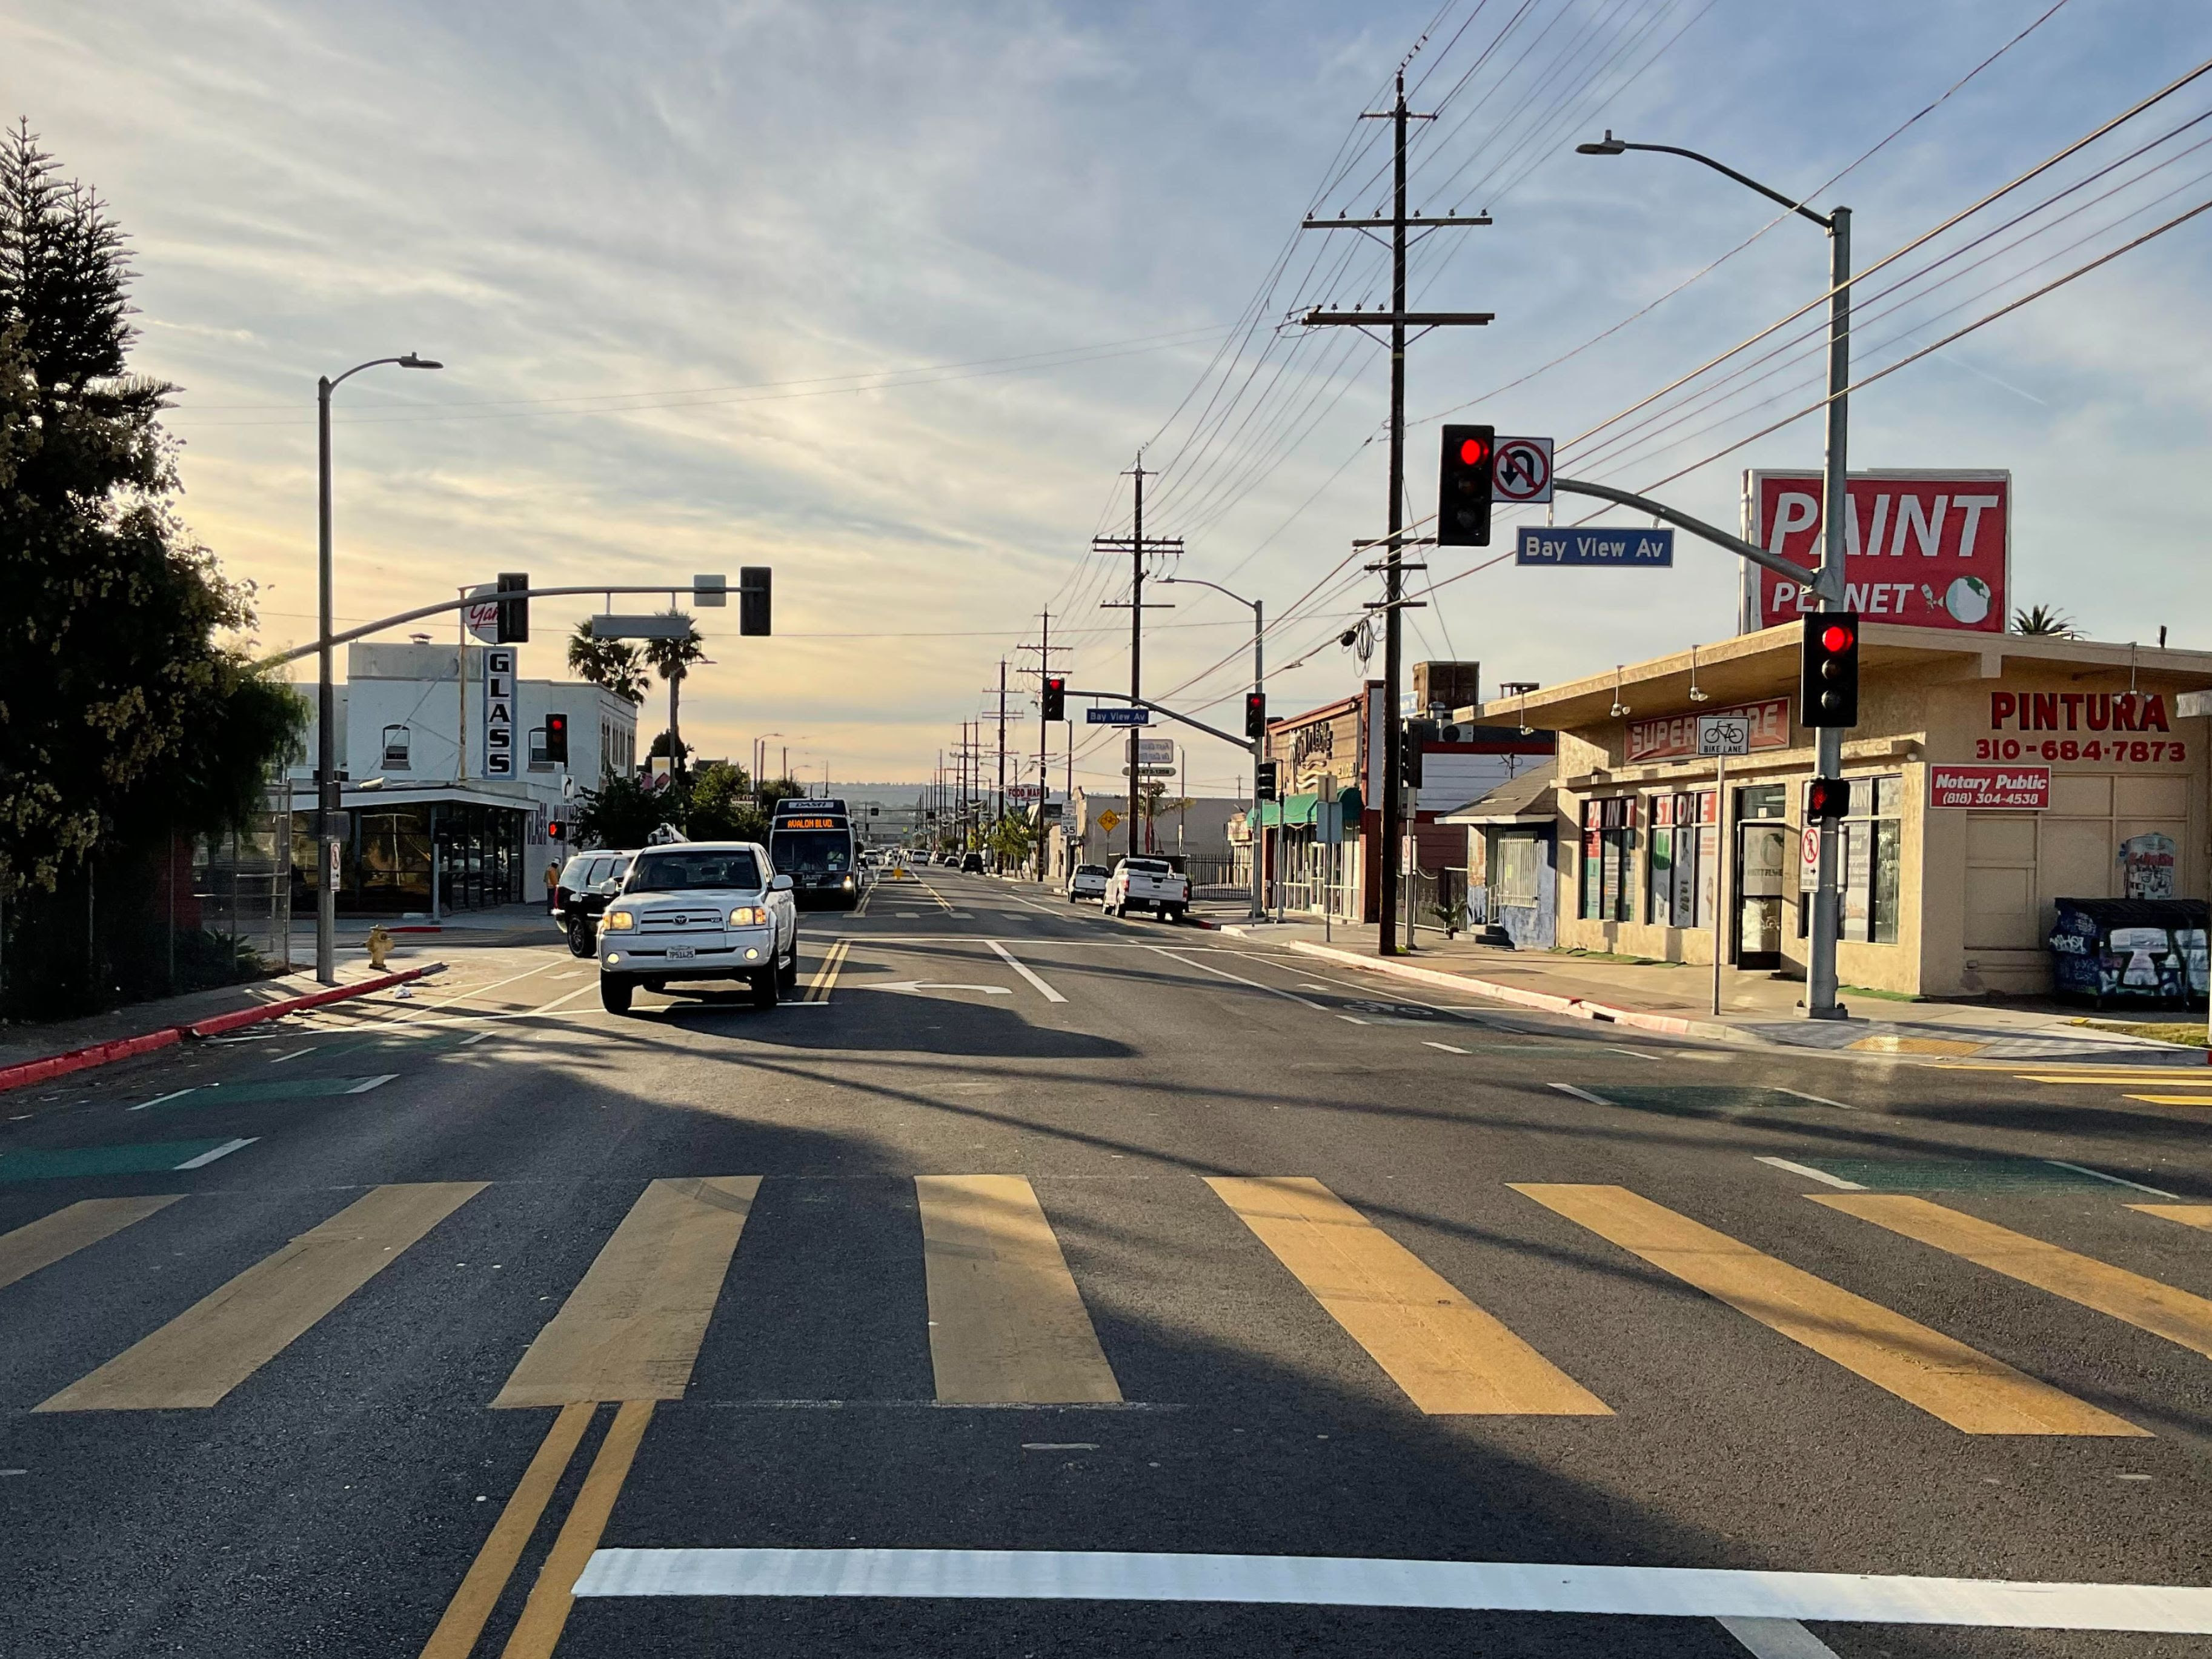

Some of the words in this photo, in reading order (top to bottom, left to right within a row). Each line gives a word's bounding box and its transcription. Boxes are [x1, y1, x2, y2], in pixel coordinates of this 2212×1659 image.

[1769, 492, 1999, 557] PAINT
[1526, 536, 1567, 561] Bay
[1576, 537, 1626, 557] View
[1635, 537, 1663, 557] Av
[1772, 582, 1915, 613] PLNET
[488, 653, 510, 773] GLASS
[1091, 712, 1107, 722] Bay
[1110, 712, 1130, 720] View
[1134, 712, 1145, 720] Av
[1991, 691, 2170, 733] PINTURA
[1632, 717, 1696, 753] SUPER
[1008, 788, 1025, 797] FOOD
[1028, 788, 1040, 797] MAR
[1935, 774, 1991, 793] Notary
[1995, 774, 2047, 790] Public
[1943, 792, 1972, 805] (818)
[1976, 793, 2039, 805] 304-4538
[788, 819, 814, 828] AVALON
[1588, 799, 1635, 828] PAINT
[1063, 826, 1075, 834] 35
